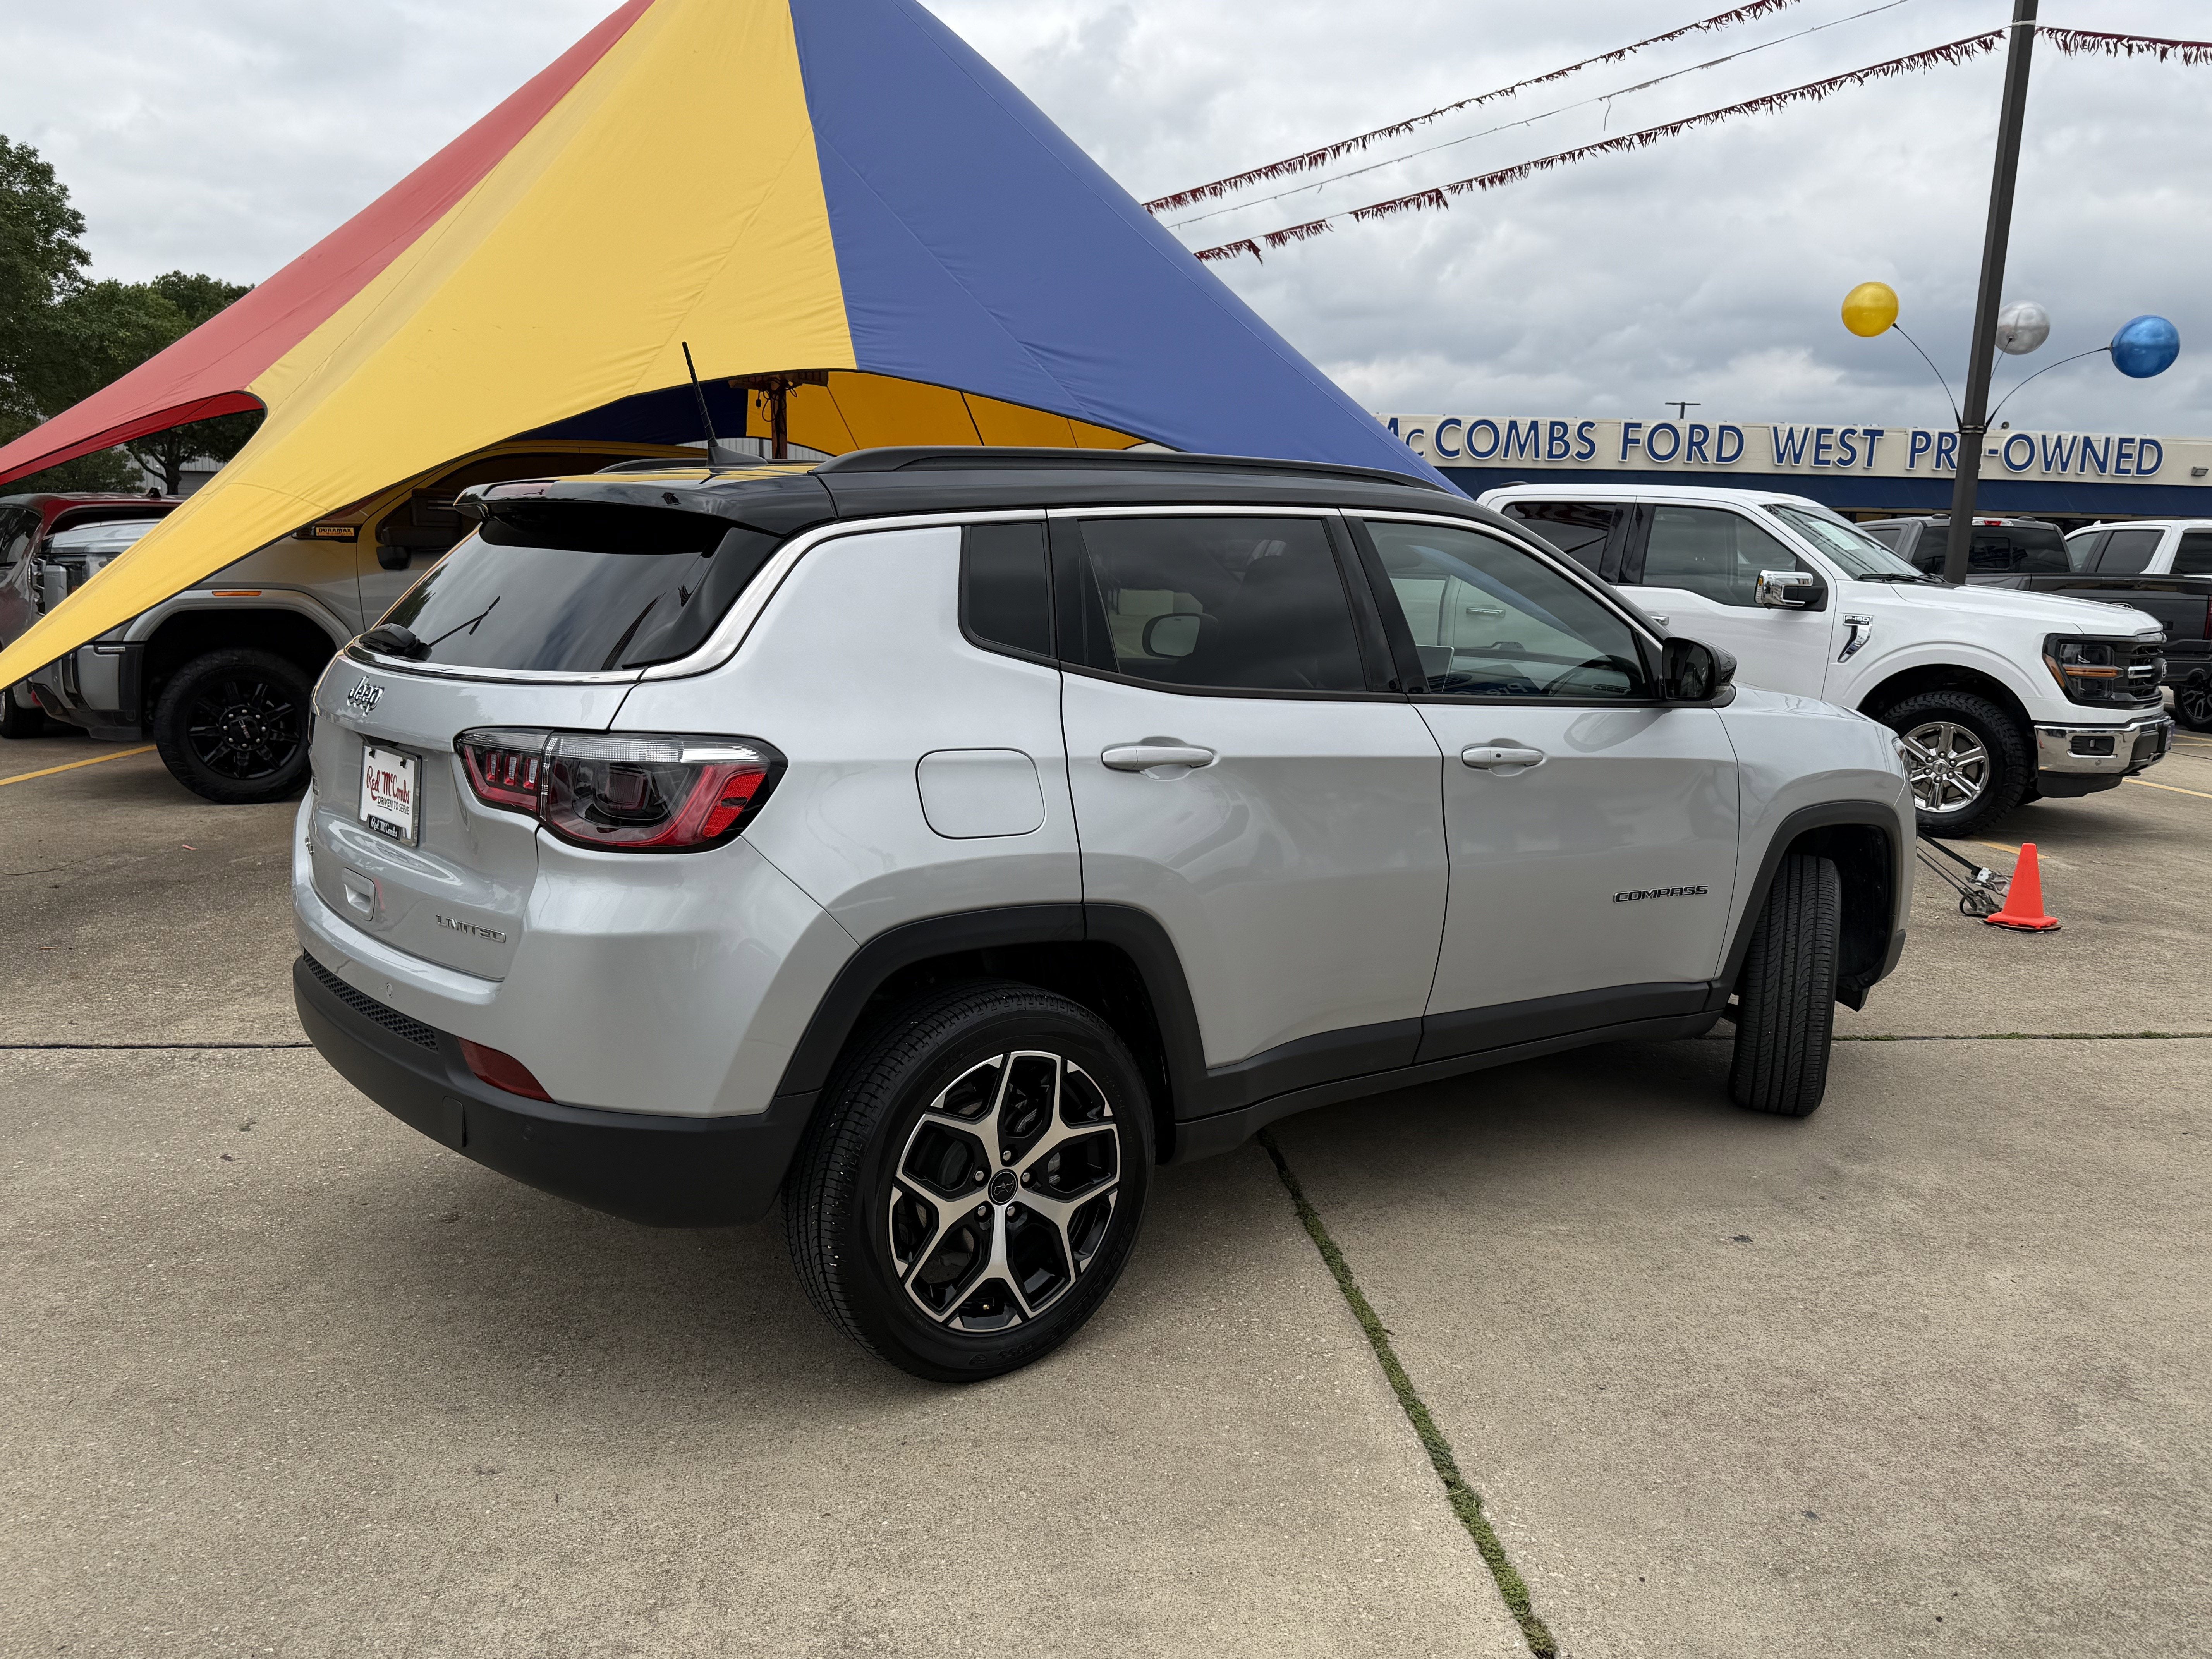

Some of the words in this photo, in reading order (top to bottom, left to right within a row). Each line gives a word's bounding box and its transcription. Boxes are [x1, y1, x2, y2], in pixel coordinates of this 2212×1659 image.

[1619, 422, 1745, 464] FORD
[1770, 426, 1884, 468] WEST
[1905, 430, 2164, 476] PR-OWNED
[347, 676, 384, 716] Jeep
[366, 765, 381, 801] Red
[377, 795, 393, 809] DRIVEN
[394, 800, 398, 810] TO
[371, 817, 380, 830] Red
[1613, 884, 1709, 903] COMPASS
[436, 914, 506, 943] LIMITED
